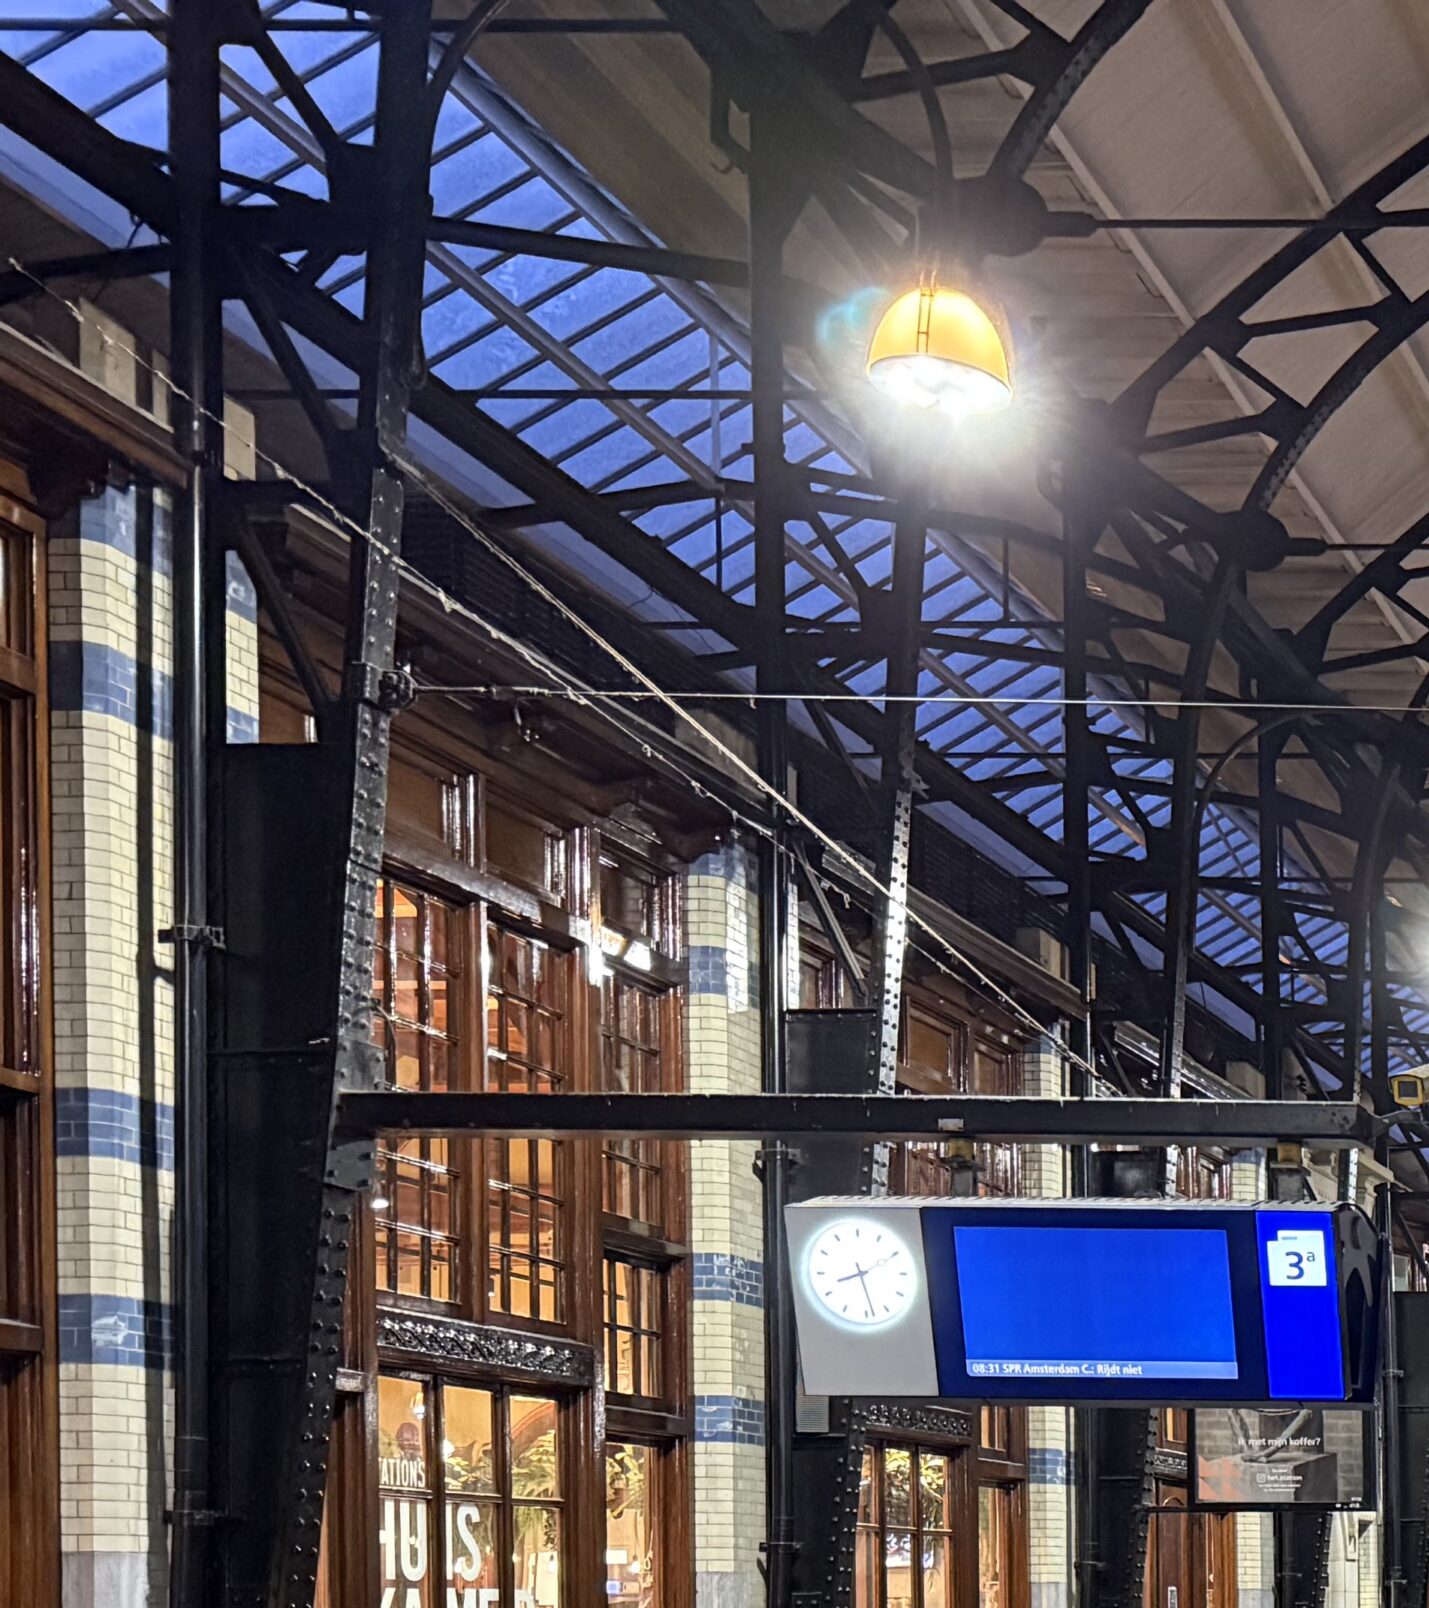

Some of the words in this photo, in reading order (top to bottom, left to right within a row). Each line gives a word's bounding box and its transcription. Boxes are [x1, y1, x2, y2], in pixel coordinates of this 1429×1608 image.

[972, 1363, 1000, 1374] 08:31
[1002, 1363, 1022, 1374] SPR
[1023, 1363, 1080, 1375] Amsterdam
[1096, 1363, 1121, 1377] Rijdt
[1122, 1364, 1143, 1375] niet
[1289, 1436, 1321, 1446] koffer?
[379, 1499, 482, 1582] HUIS
